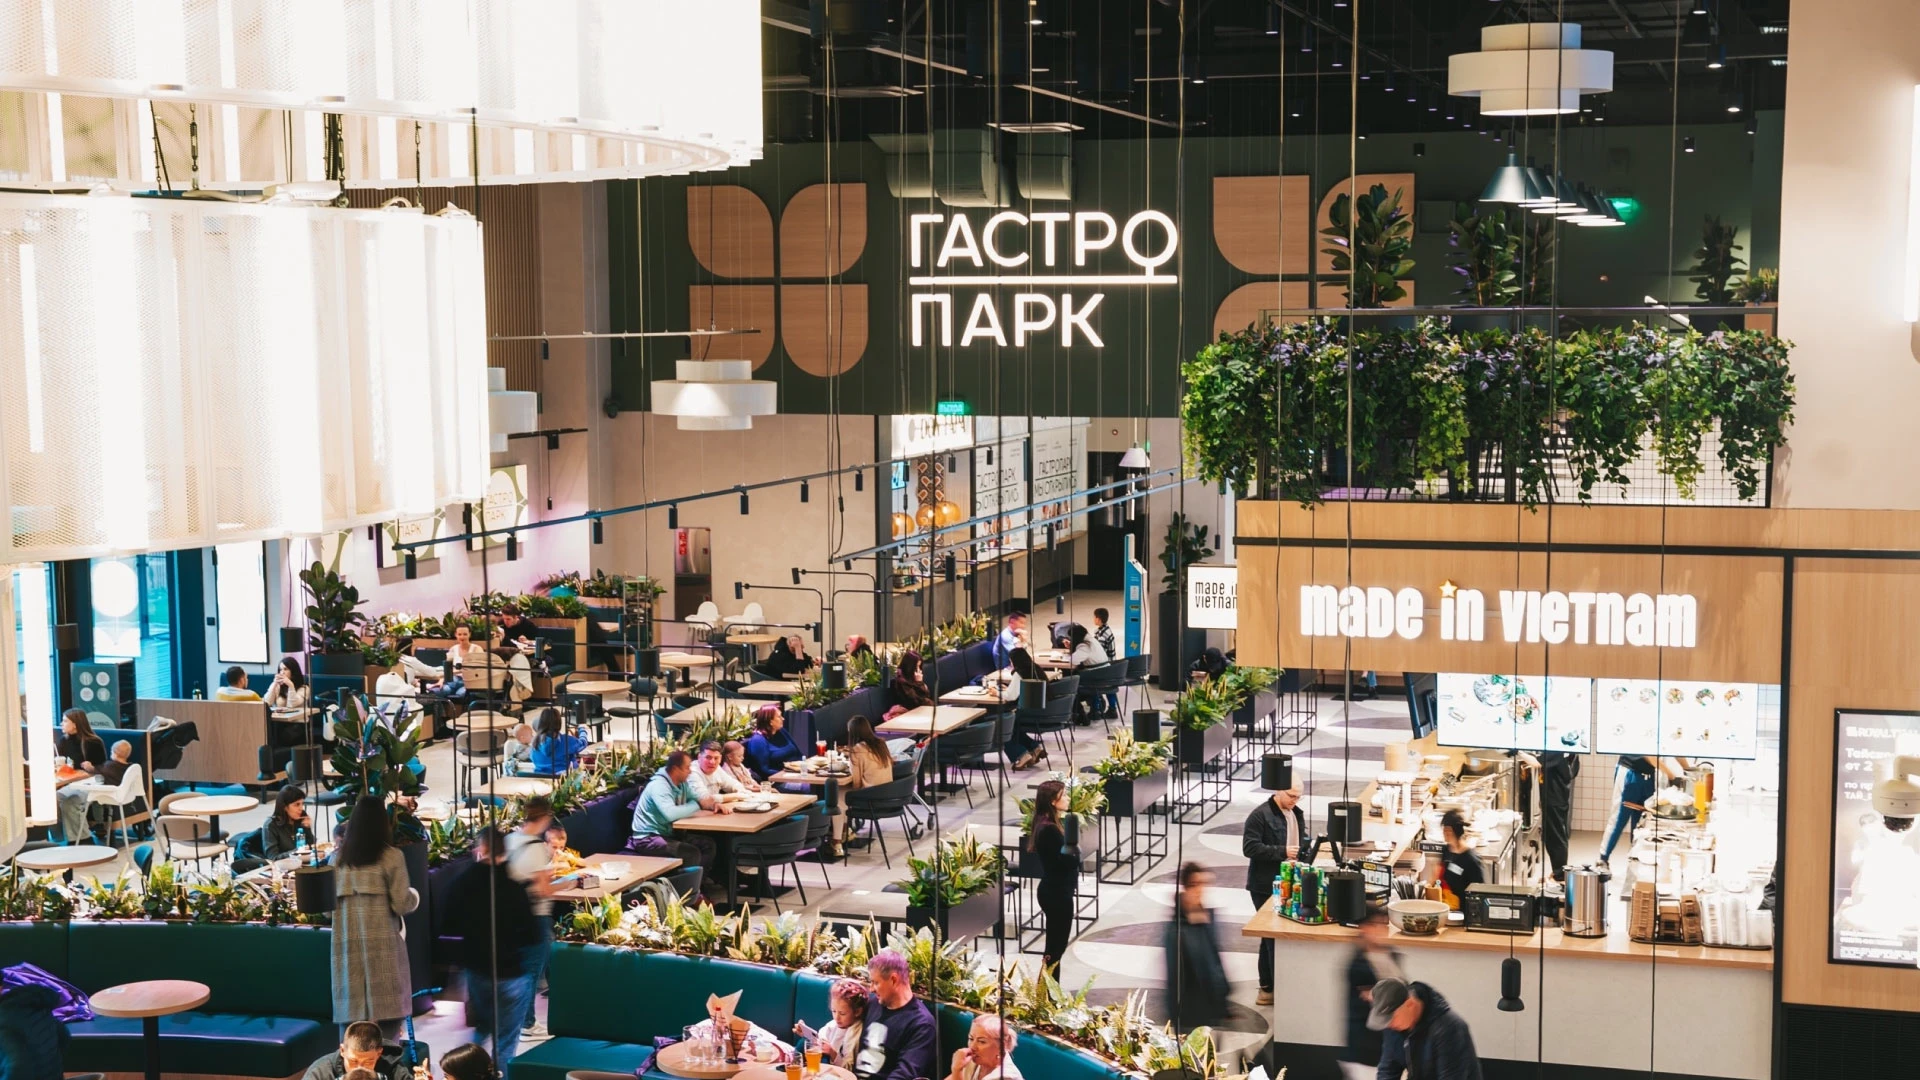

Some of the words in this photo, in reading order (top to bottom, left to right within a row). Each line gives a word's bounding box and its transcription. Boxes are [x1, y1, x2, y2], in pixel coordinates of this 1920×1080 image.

[910, 210, 1178, 270] ГАСТРО
[911, 293, 1105, 347] ПАРК
[1441, 584, 1484, 641] in
